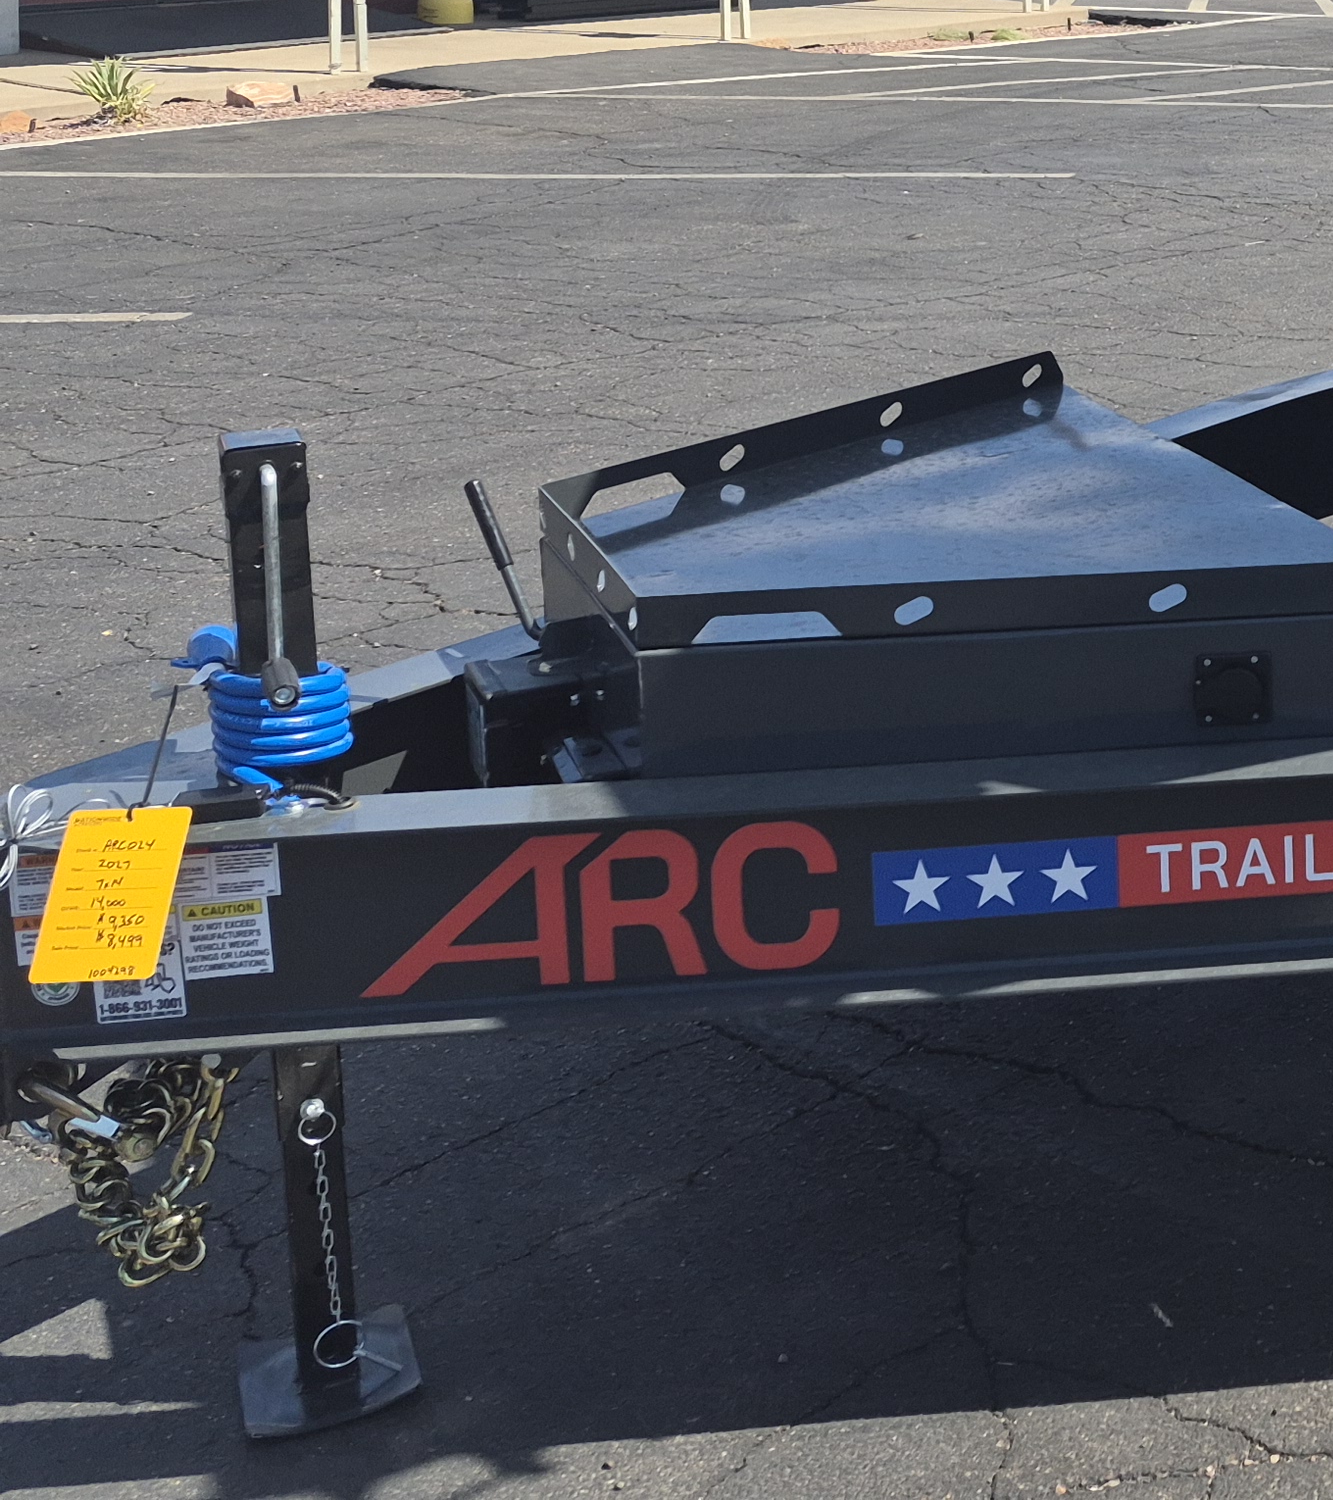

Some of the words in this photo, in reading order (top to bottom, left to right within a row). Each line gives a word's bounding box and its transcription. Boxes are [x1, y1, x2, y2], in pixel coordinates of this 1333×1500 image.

[201, 902, 255, 916] CAUTION
[359, 819, 842, 998] ARC
[192, 924, 205, 932] DO
[206, 922, 222, 930] NOT
[224, 919, 256, 929] EXCEED
[189, 929, 261, 942] MANUFACTURER'S
[193, 941, 226, 952] VEHICLE
[228, 939, 259, 948] WEIGHT
[185, 953, 219, 963] RATINGS
[221, 951, 233, 959] OR
[234, 949, 270, 958] LOADING
[99, 997, 182, 1015] 1-866-931-3001
